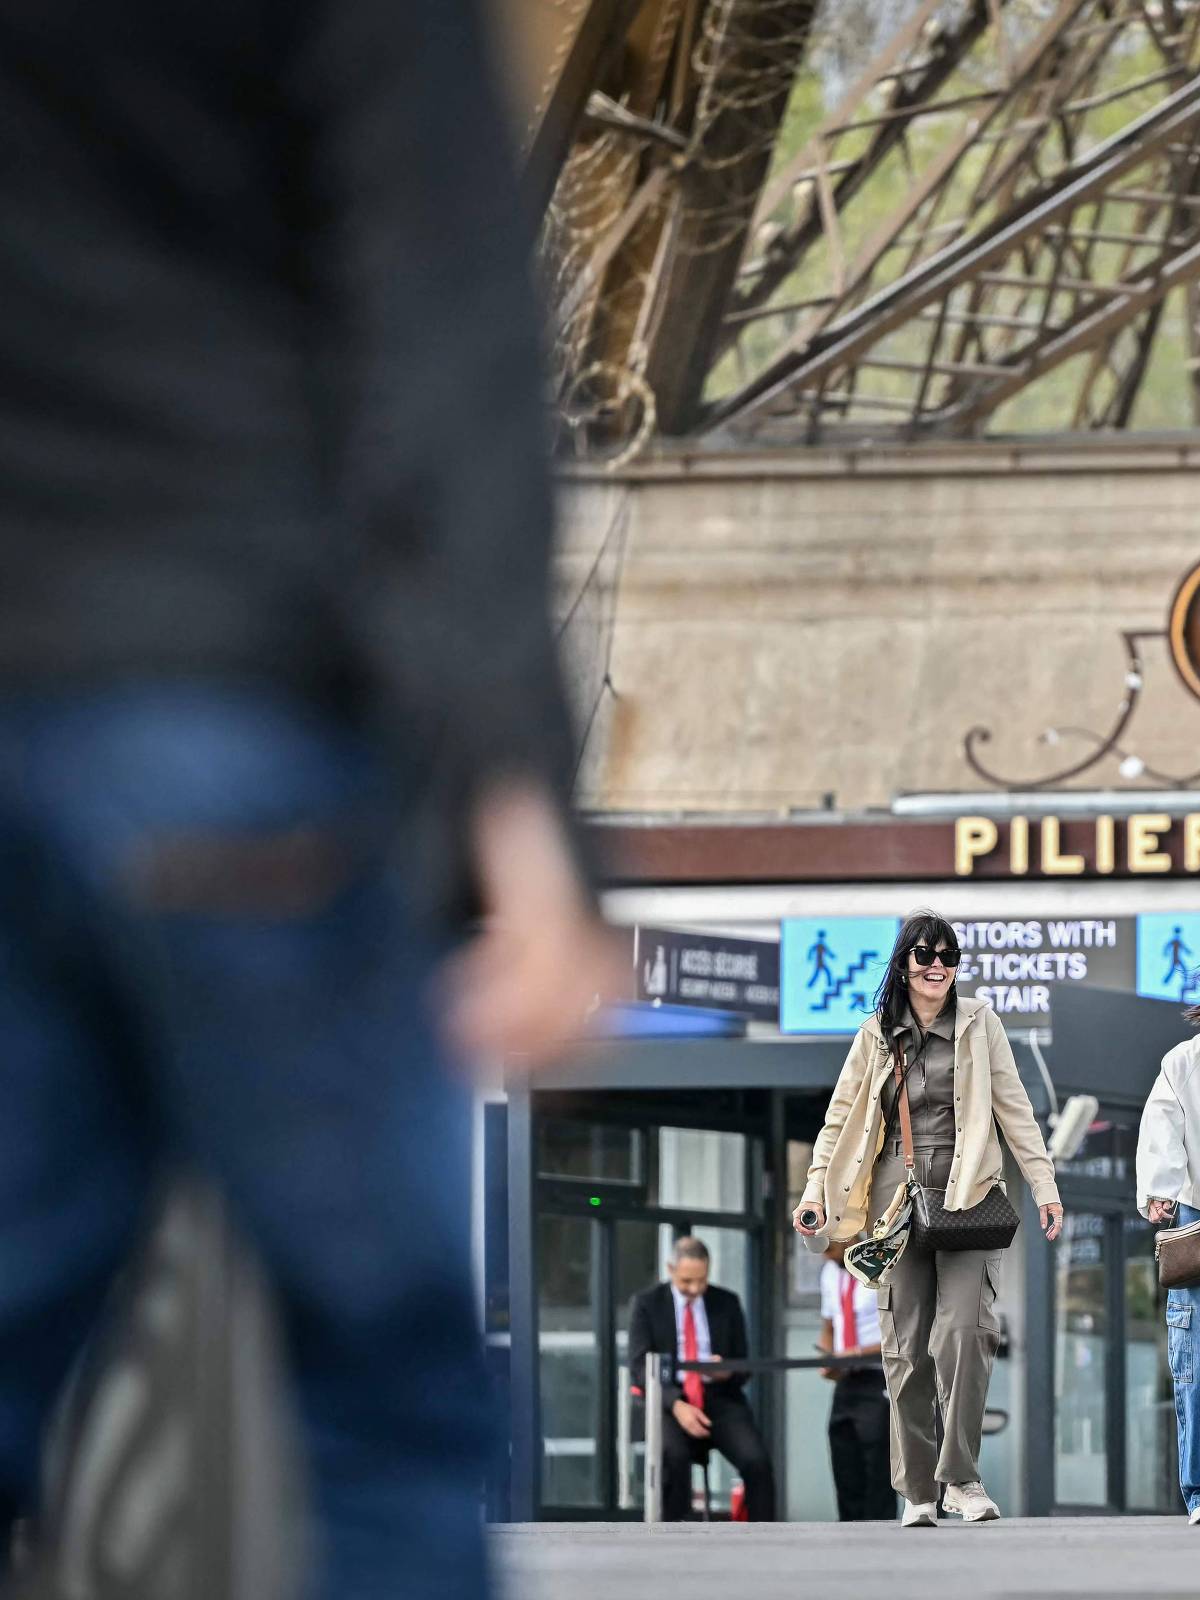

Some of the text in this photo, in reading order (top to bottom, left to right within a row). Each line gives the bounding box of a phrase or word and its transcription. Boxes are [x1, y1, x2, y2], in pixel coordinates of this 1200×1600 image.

[950, 920, 1116, 949] SITORS WITH
[957, 952, 1087, 981] E-TICKETS
[975, 985, 1050, 1013] STAIR
